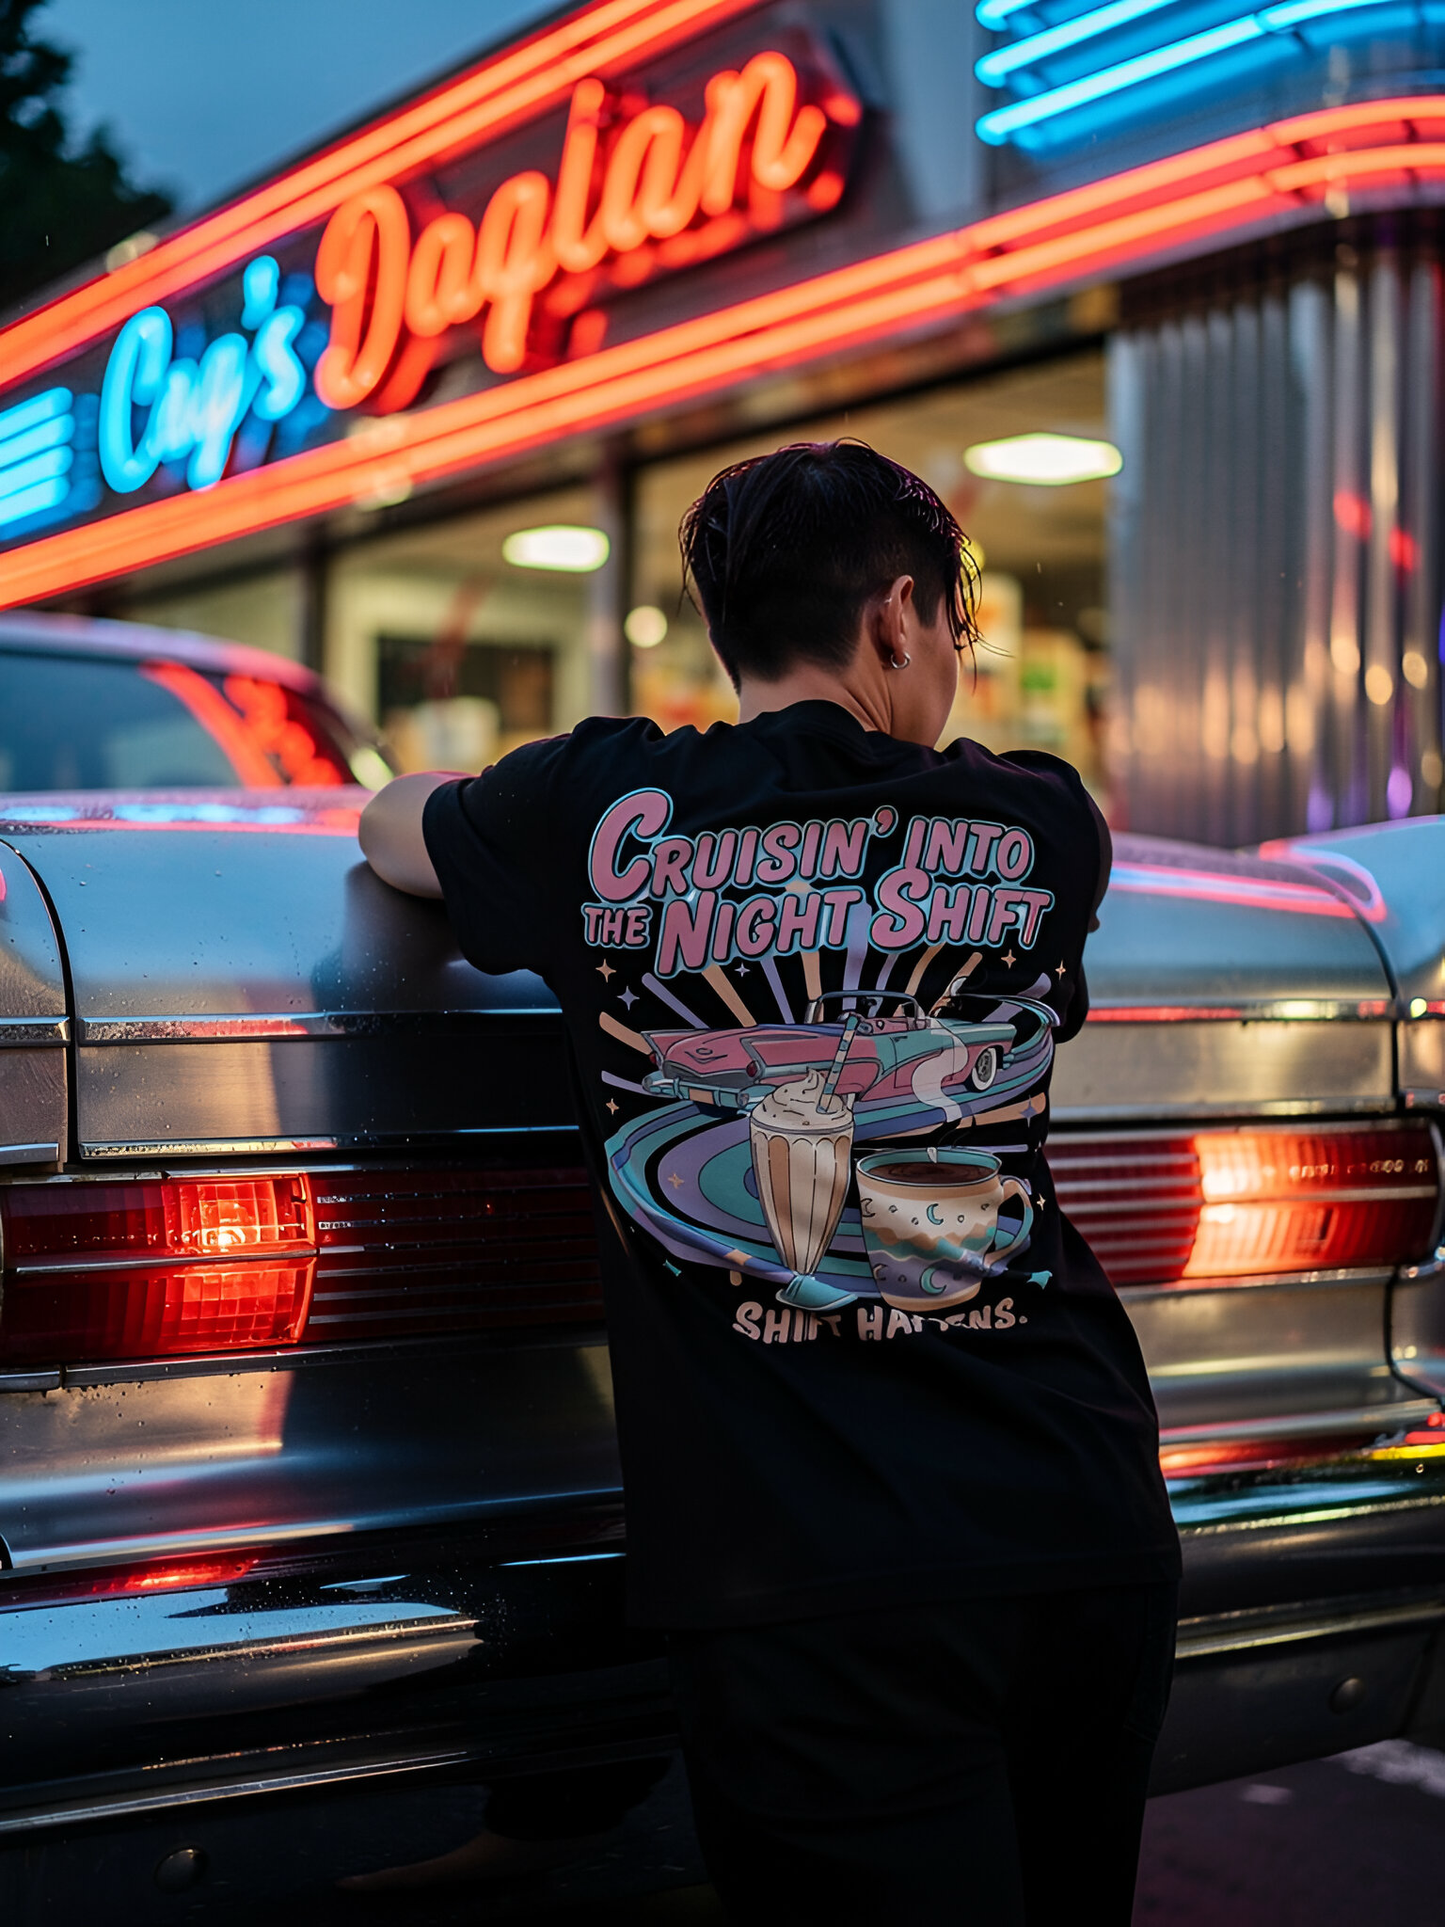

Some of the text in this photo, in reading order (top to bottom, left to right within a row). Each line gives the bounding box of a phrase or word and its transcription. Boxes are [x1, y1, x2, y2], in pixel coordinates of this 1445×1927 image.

[589, 788, 1034, 901] CRUISIN' INTO
[582, 865, 1054, 978] THE NIGHT SHIFT
[857, 1297, 1029, 1341] HANS.
